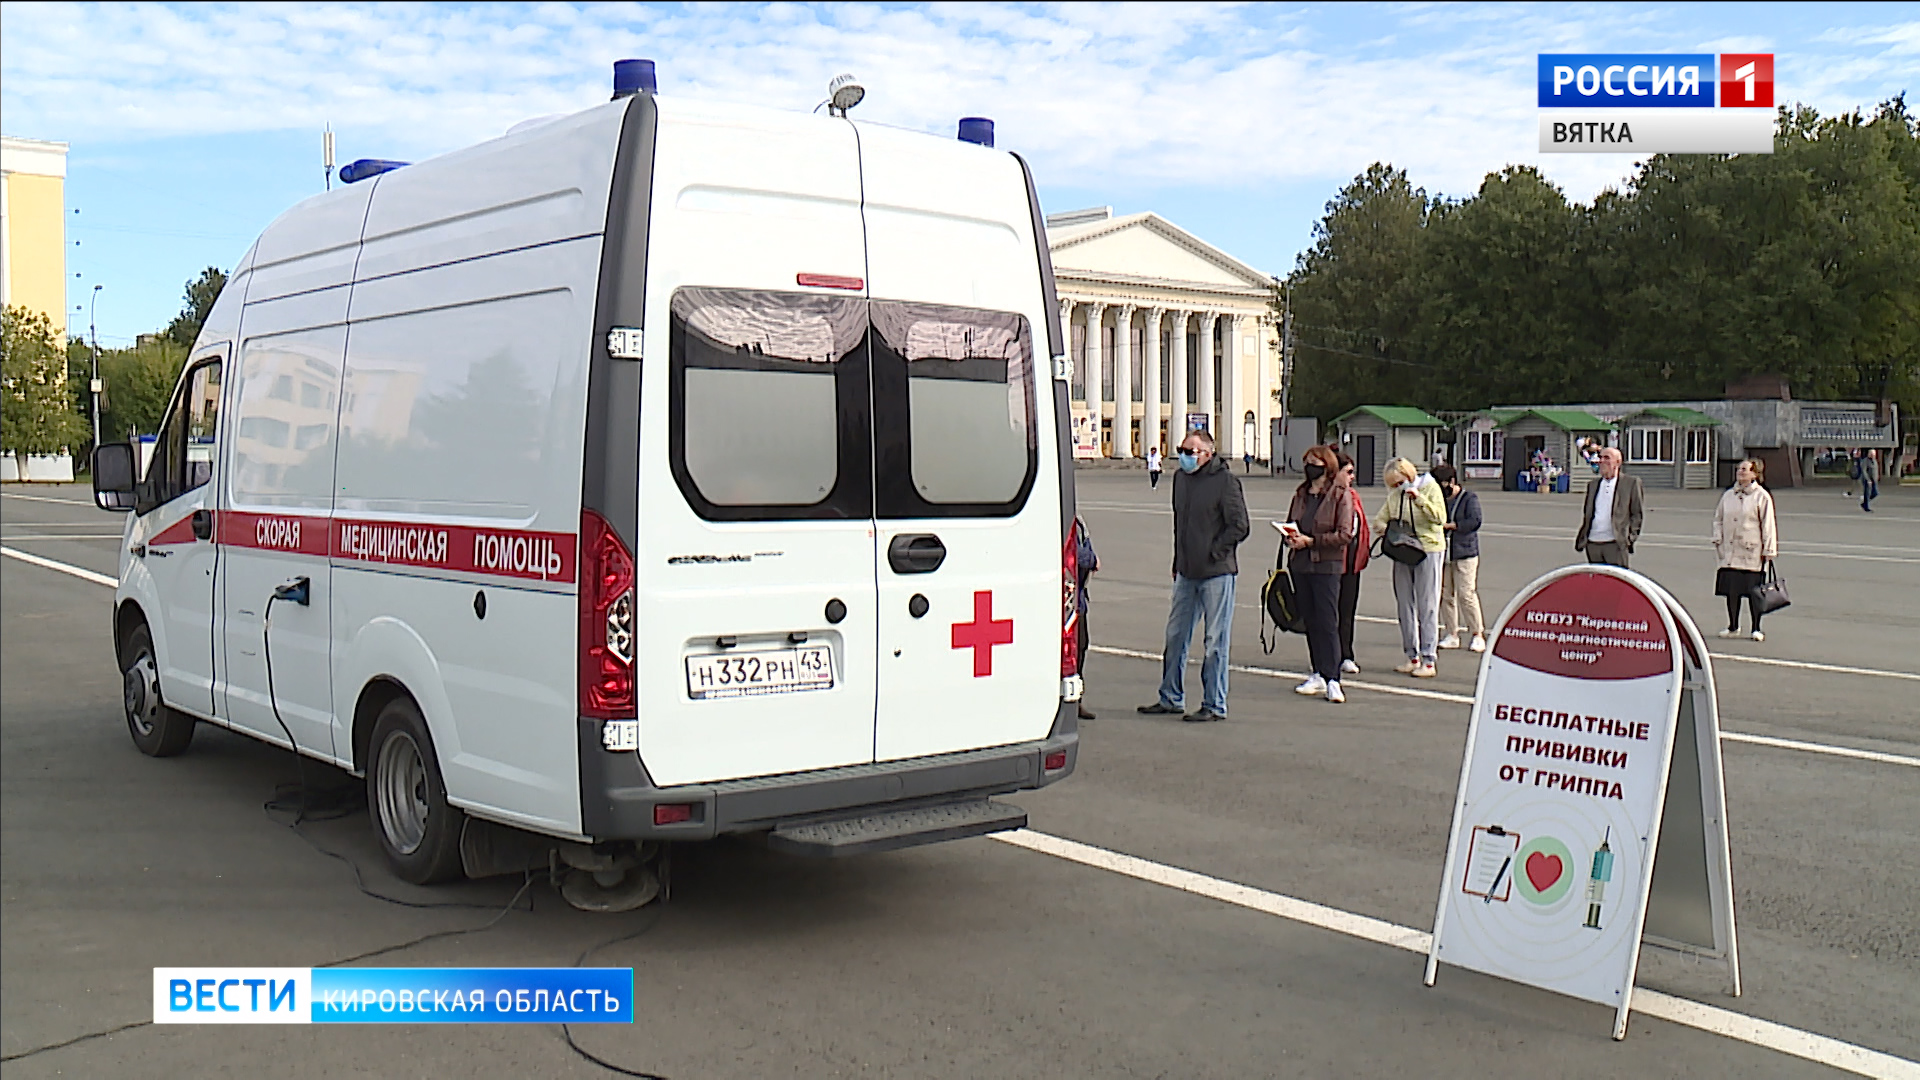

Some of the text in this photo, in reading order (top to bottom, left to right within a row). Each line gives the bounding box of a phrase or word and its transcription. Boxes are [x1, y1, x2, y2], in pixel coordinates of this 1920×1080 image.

[256, 517, 562, 581] СКОРАЯ МЕДИЦИНСКАЯ ПОМОЩЬ
[1526, 611, 1649, 632] КОГБУЗ "Кировский
[1504, 627, 1667, 651] клинико-диагностический
[699, 651, 822, 686] Н332РН 43
[1560, 650, 1603, 664] центр"
[1495, 703, 1650, 741] БЕСПЛАТНЫЕ
[1506, 735, 1628, 769] ПРИВИВКИ
[1499, 764, 1624, 800] ОТ ГРИППА
